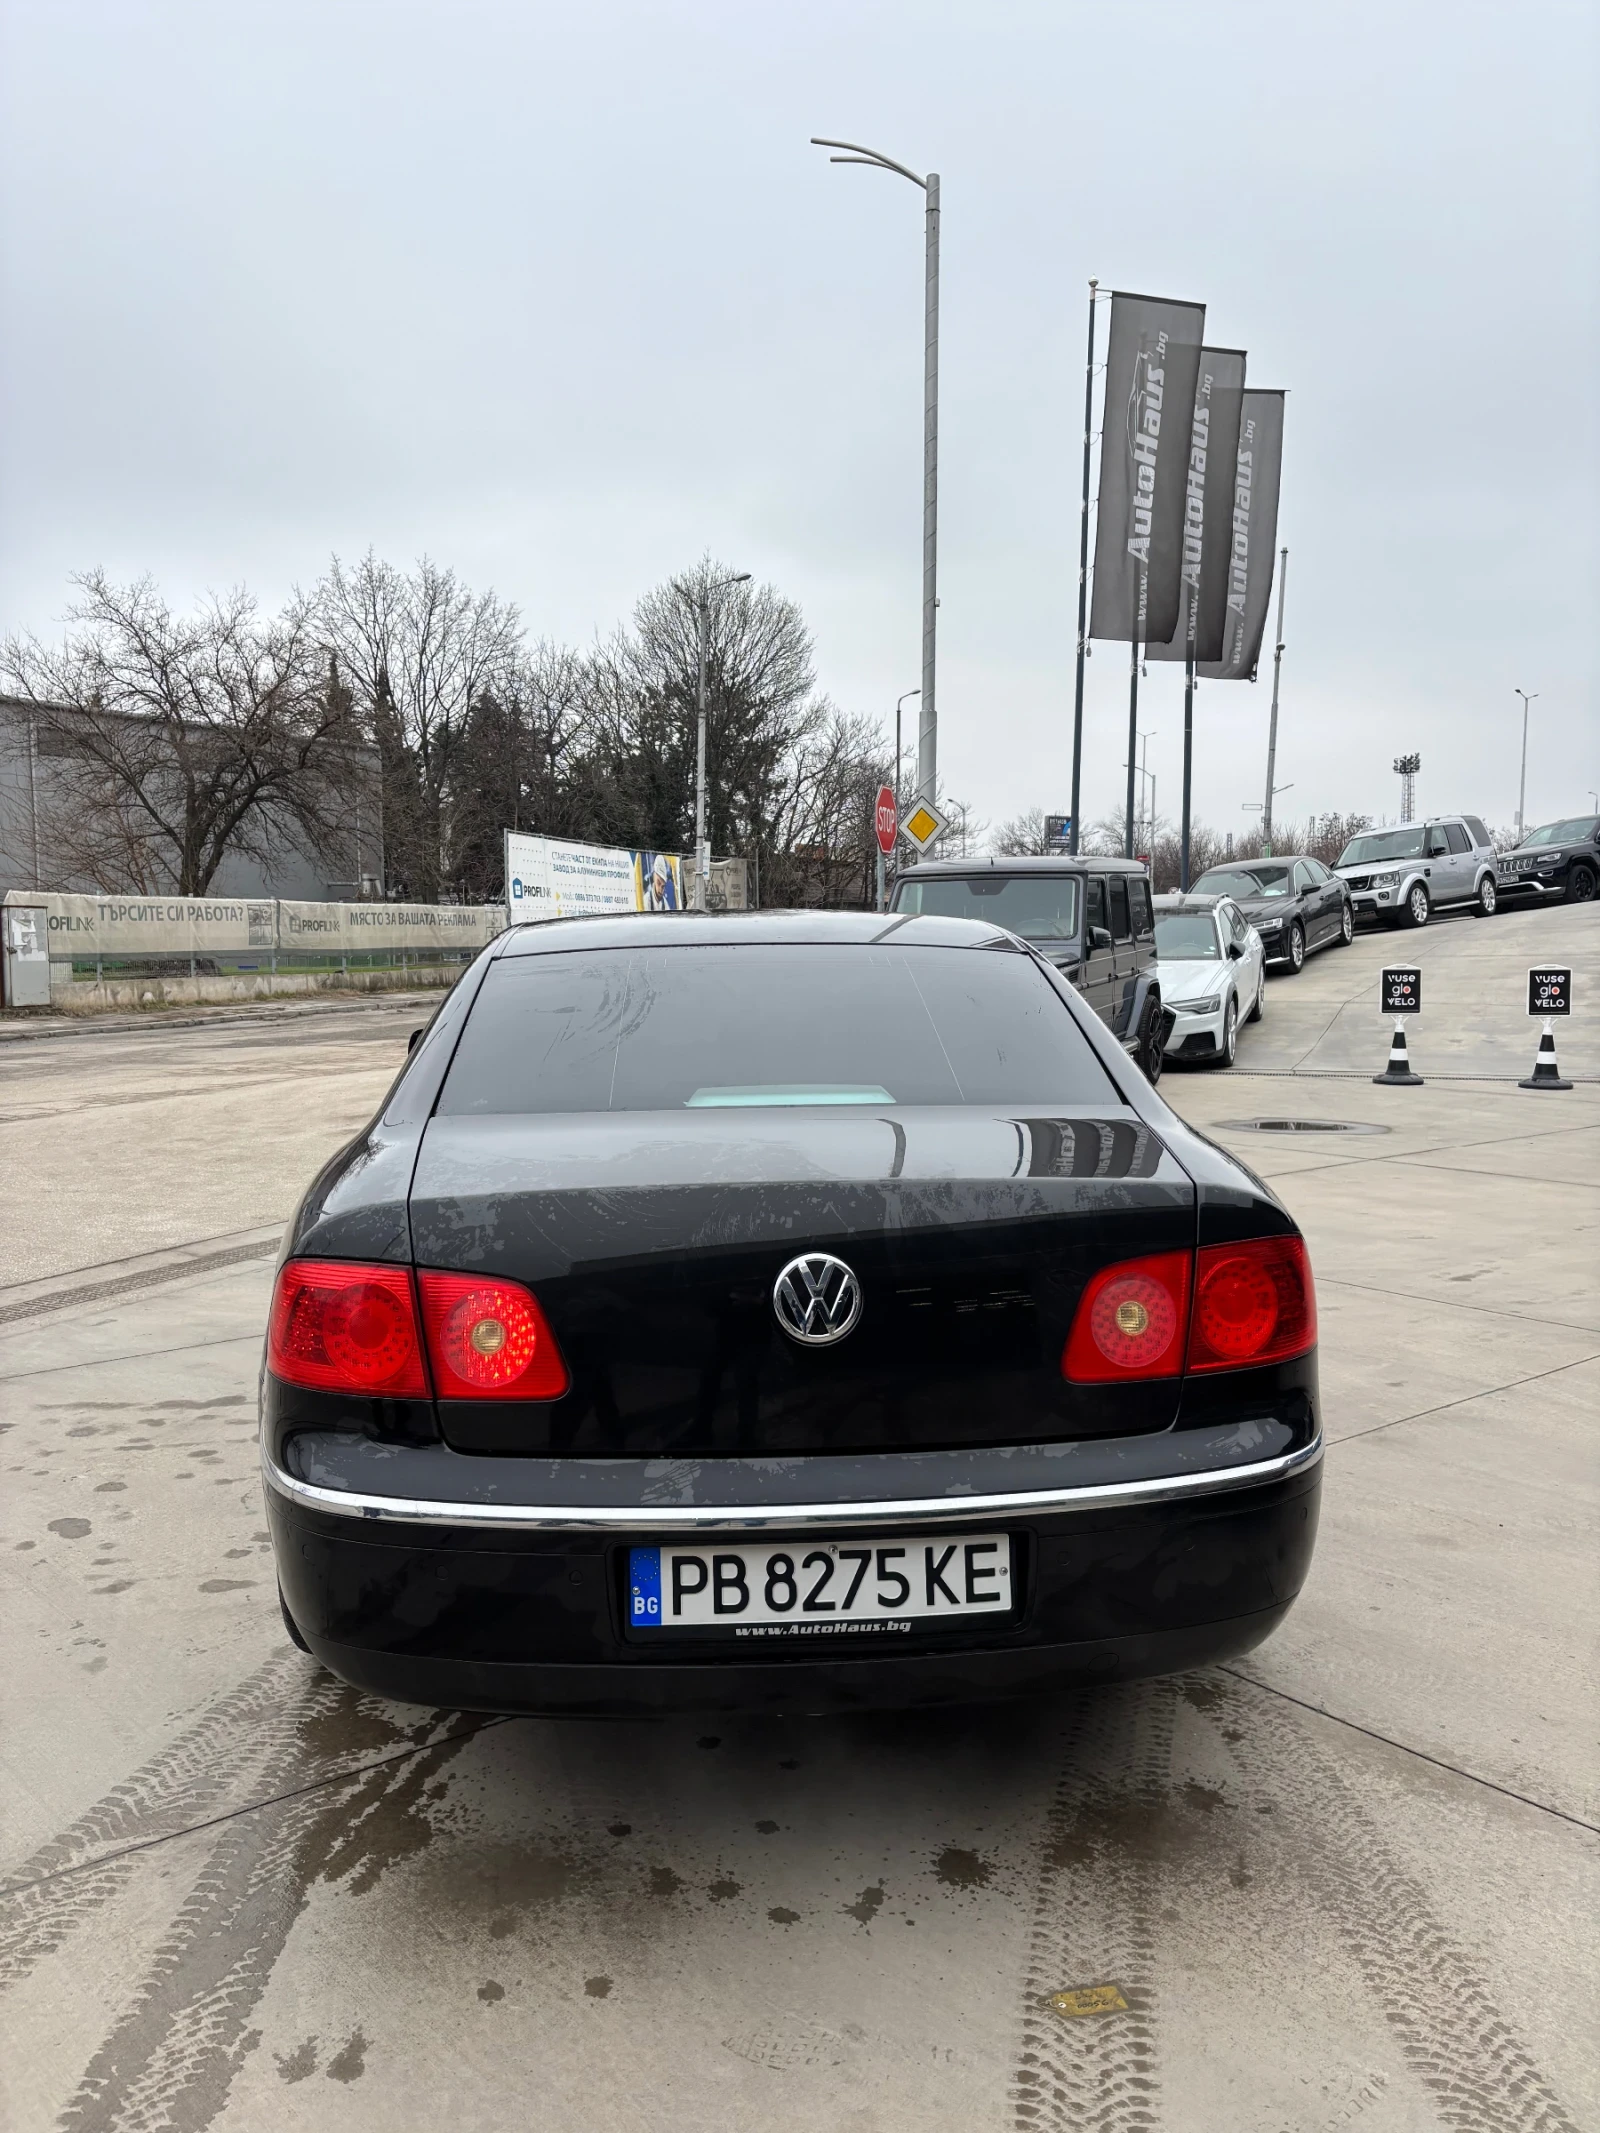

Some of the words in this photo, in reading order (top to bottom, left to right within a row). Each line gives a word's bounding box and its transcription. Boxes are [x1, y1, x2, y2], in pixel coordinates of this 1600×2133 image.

[878, 805, 895, 834] STOP
[98, 903, 164, 922] ТЪРСИТЕ
[166, 905, 184, 921] СИ
[187, 906, 244, 922] РАБОТА?
[350, 912, 384, 926] МЯСТО
[385, 912, 396, 926] ЗА
[399, 912, 436, 926] ВАШАТА
[437, 913, 477, 927] РЕКЛАМА
[46, 916, 94, 931] OFILINK
[302, 920, 340, 933] PROFILINK
[1391, 983, 1412, 997] glo
[1539, 984, 1560, 998] glo
[1386, 997, 1416, 1006] VELO
[1534, 998, 1565, 1007] VELO
[671, 1555, 750, 1615] PB
[763, 1548, 911, 1613] 8275
[924, 1542, 1002, 1606] KE
[633, 1596, 658, 1615] BG
[735, 1620, 912, 1637] www.AutoHaus.bg
